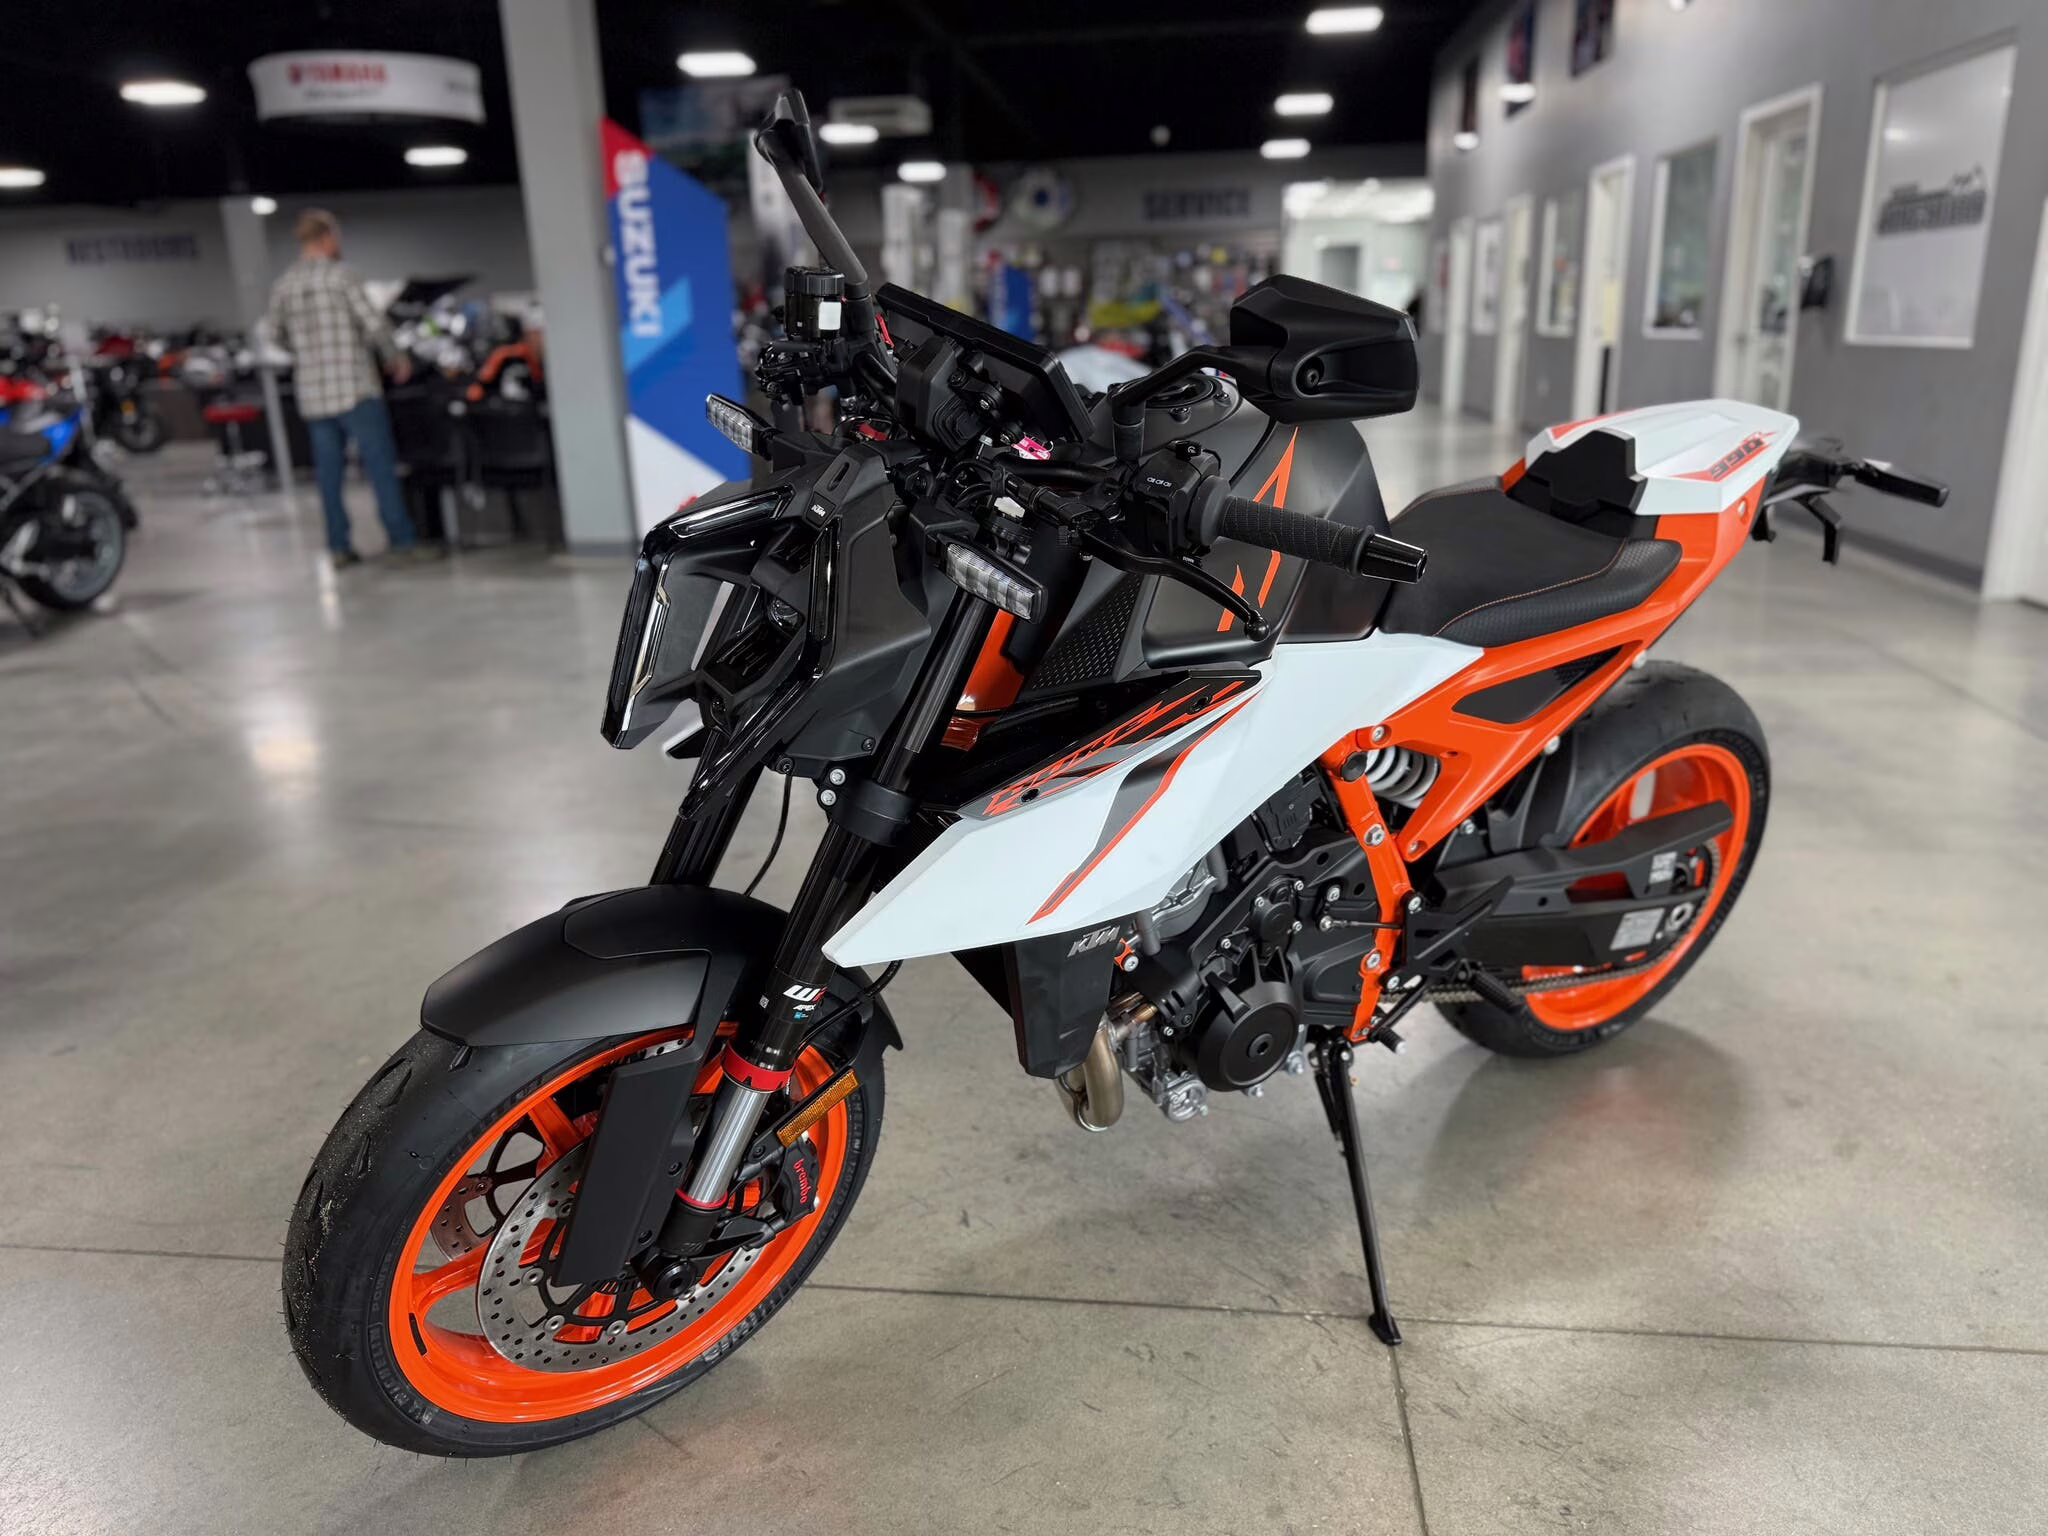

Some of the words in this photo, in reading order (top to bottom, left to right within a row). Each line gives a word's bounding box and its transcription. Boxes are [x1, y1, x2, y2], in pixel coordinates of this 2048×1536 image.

[613, 150, 662, 337] SUZUKI
[811, 504, 826, 517] KTM
[1066, 925, 1121, 958] KTM
[793, 1158, 813, 1204] brembo
[371, 1252, 393, 1312] POWER
[368, 1326, 409, 1406] MICHELIN
